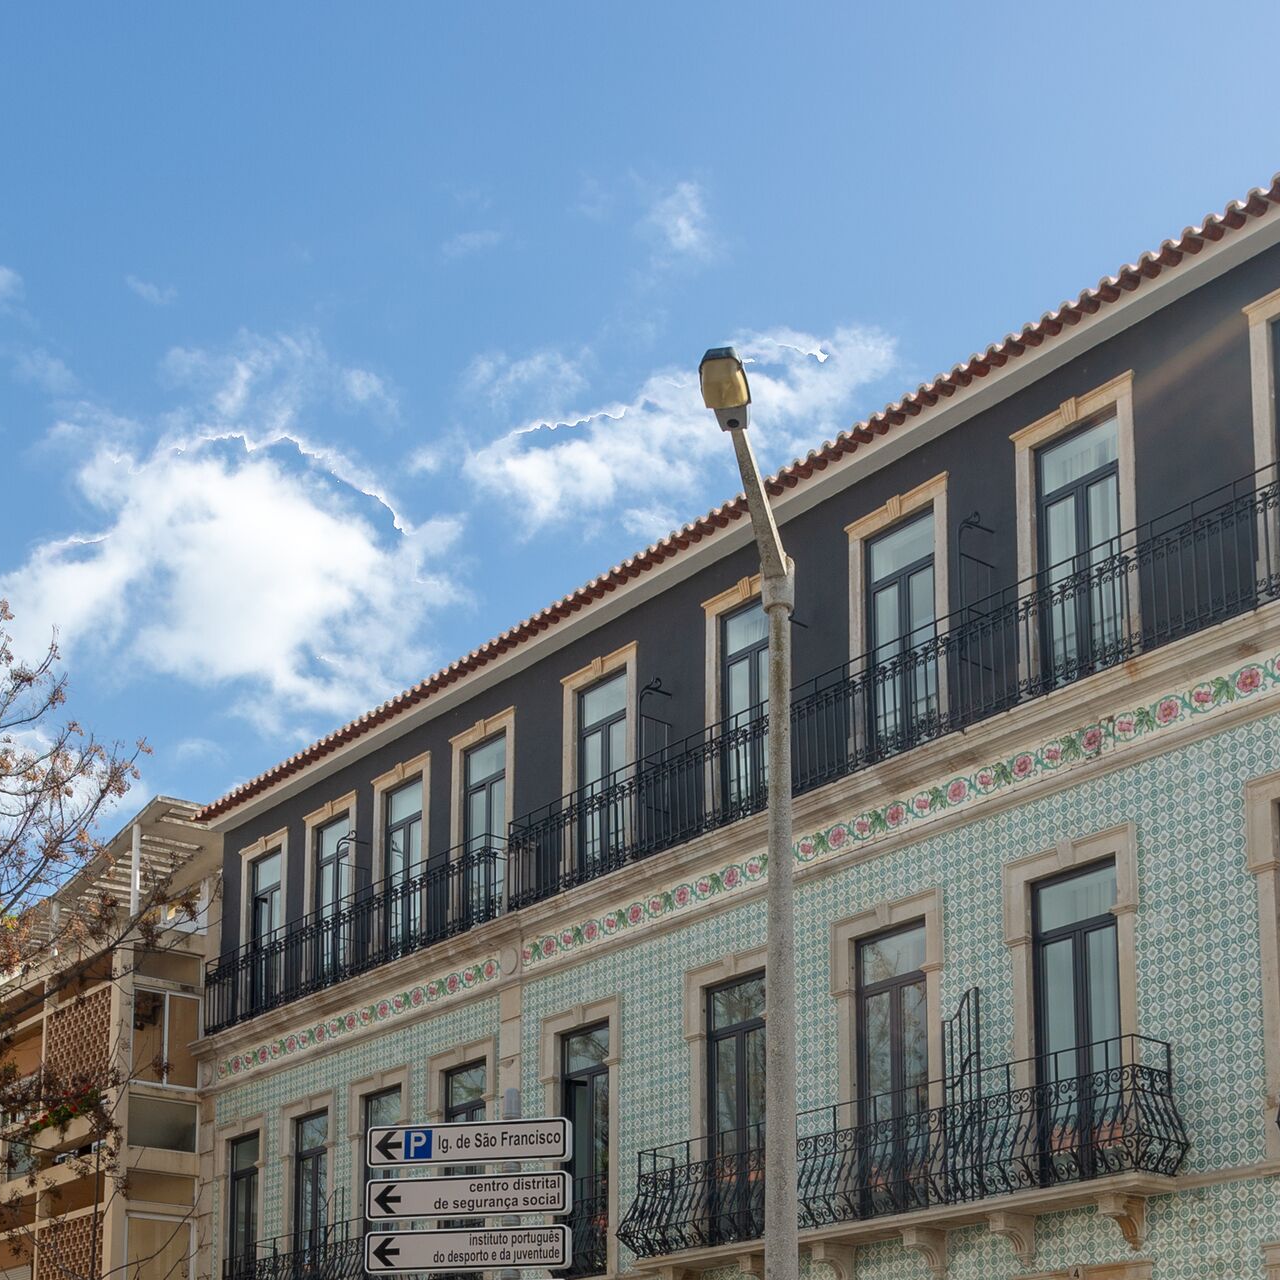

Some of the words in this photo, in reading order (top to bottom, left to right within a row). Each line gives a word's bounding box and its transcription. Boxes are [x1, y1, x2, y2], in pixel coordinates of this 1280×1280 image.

[410, 1132, 427, 1158] P
[456, 1133, 470, 1149] de
[475, 1132, 497, 1149] São
[501, 1130, 561, 1147] Francisco
[469, 1180, 509, 1193] centro
[513, 1177, 560, 1191] distrital
[434, 1197, 449, 1210] de
[453, 1196, 519, 1211] segurança
[522, 1192, 560, 1206] social
[469, 1232, 509, 1246] instituto
[511, 1230, 560, 1247] português
[433, 1251, 445, 1264] do
[447, 1249, 489, 1265] desporto
[491, 1252, 497, 1261] e
[499, 1248, 511, 1261] da
[513, 1246, 560, 1263] juventude
[1073, 1268, 1080, 1279] 4
